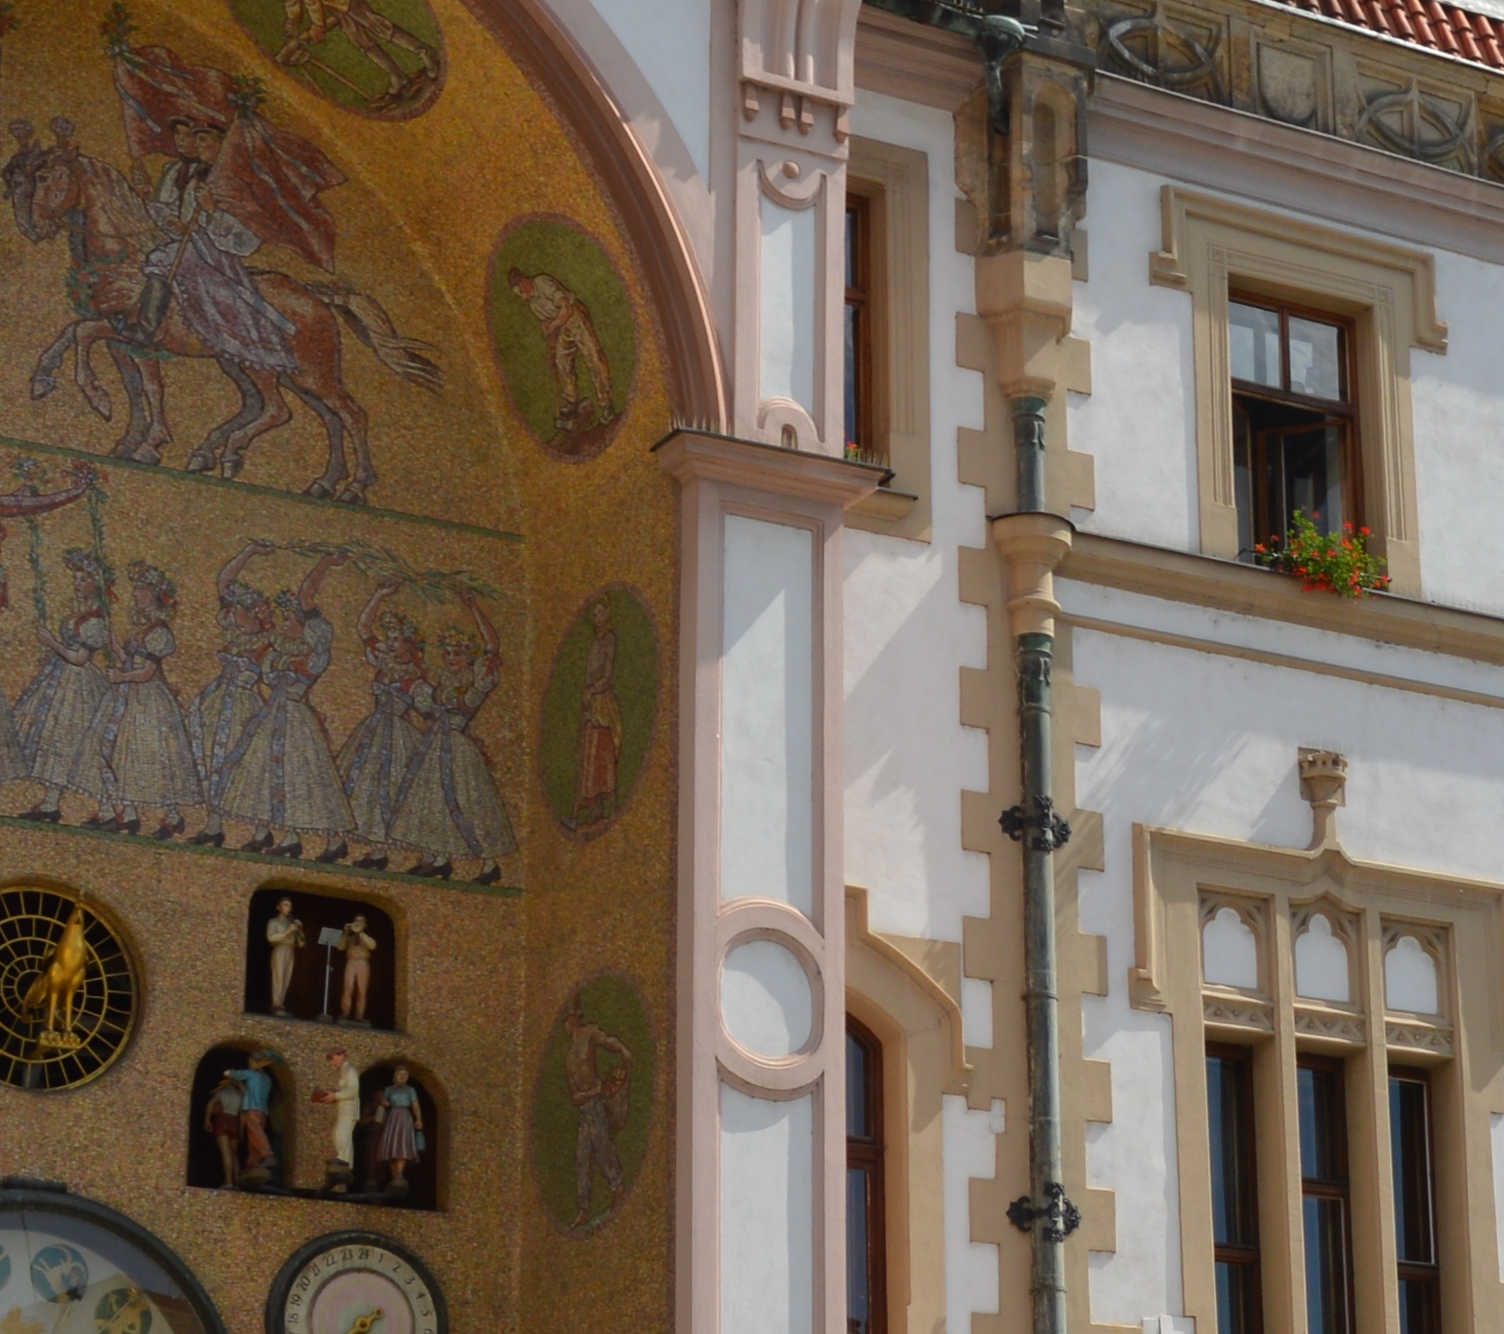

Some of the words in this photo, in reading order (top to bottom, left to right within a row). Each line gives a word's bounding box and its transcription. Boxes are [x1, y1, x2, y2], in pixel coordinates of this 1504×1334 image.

[340, 1249, 353, 1262] 23
[358, 1249, 370, 1260] 24
[322, 1255, 337, 1267] 22
[311, 1263, 322, 1277] 21
[392, 1263, 402, 1273] 2
[297, 1277, 312, 1292] 20
[405, 1276, 415, 1285] 3
[290, 1294, 302, 1307] 19
[415, 1290, 426, 1300] 4
[287, 1312, 299, 1324] 18
[421, 1309, 432, 1317] 5
